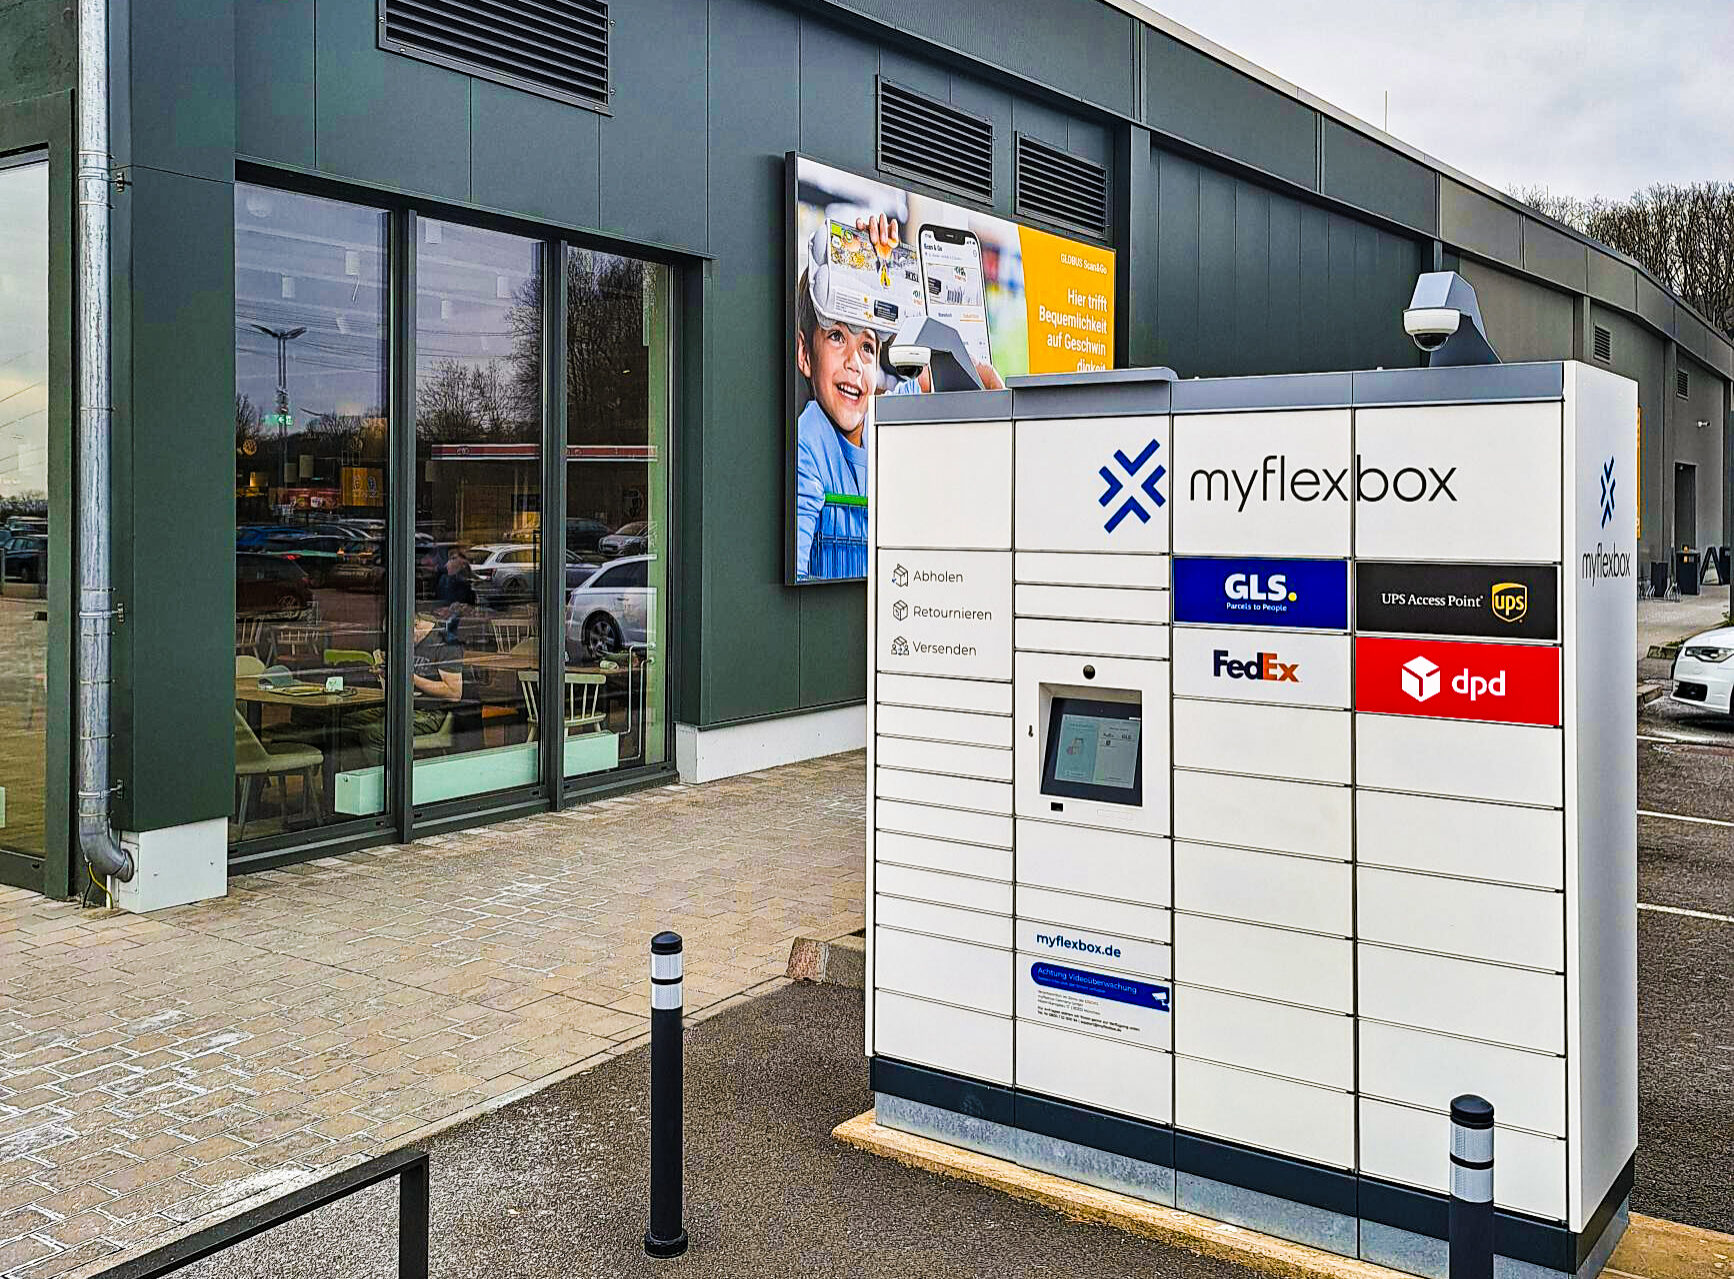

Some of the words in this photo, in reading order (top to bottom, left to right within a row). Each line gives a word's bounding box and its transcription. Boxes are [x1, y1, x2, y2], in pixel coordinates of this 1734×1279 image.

[1060, 253, 1083, 268] GLOBUS
[1067, 287, 1087, 308] Hier
[1087, 292, 1108, 313] trifft
[1039, 305, 1108, 335] Bequemlichkeit
[1047, 332, 1063, 348] auf
[1064, 333, 1106, 357] Geschwin
[1189, 453, 1458, 513] myflexbox
[913, 570, 963, 583] Abholen
[1582, 542, 1632, 587] myflexbox
[1226, 602, 1252, 611] Parcels
[1253, 603, 1261, 611] to
[1262, 603, 1287, 613] People
[1381, 592, 1406, 605] UPS
[1407, 594, 1446, 607] Access
[1494, 594, 1525, 617] ups
[913, 606, 992, 620] Retournieren
[913, 641, 976, 656] Versenden
[1213, 649, 1300, 683] FedEx
[1451, 667, 1506, 701] dpd
[1036, 933, 1121, 957] myflexbox.de
[1037, 967, 1068, 980] Achtung
[1068, 973, 1137, 994] Videoüberwachung
